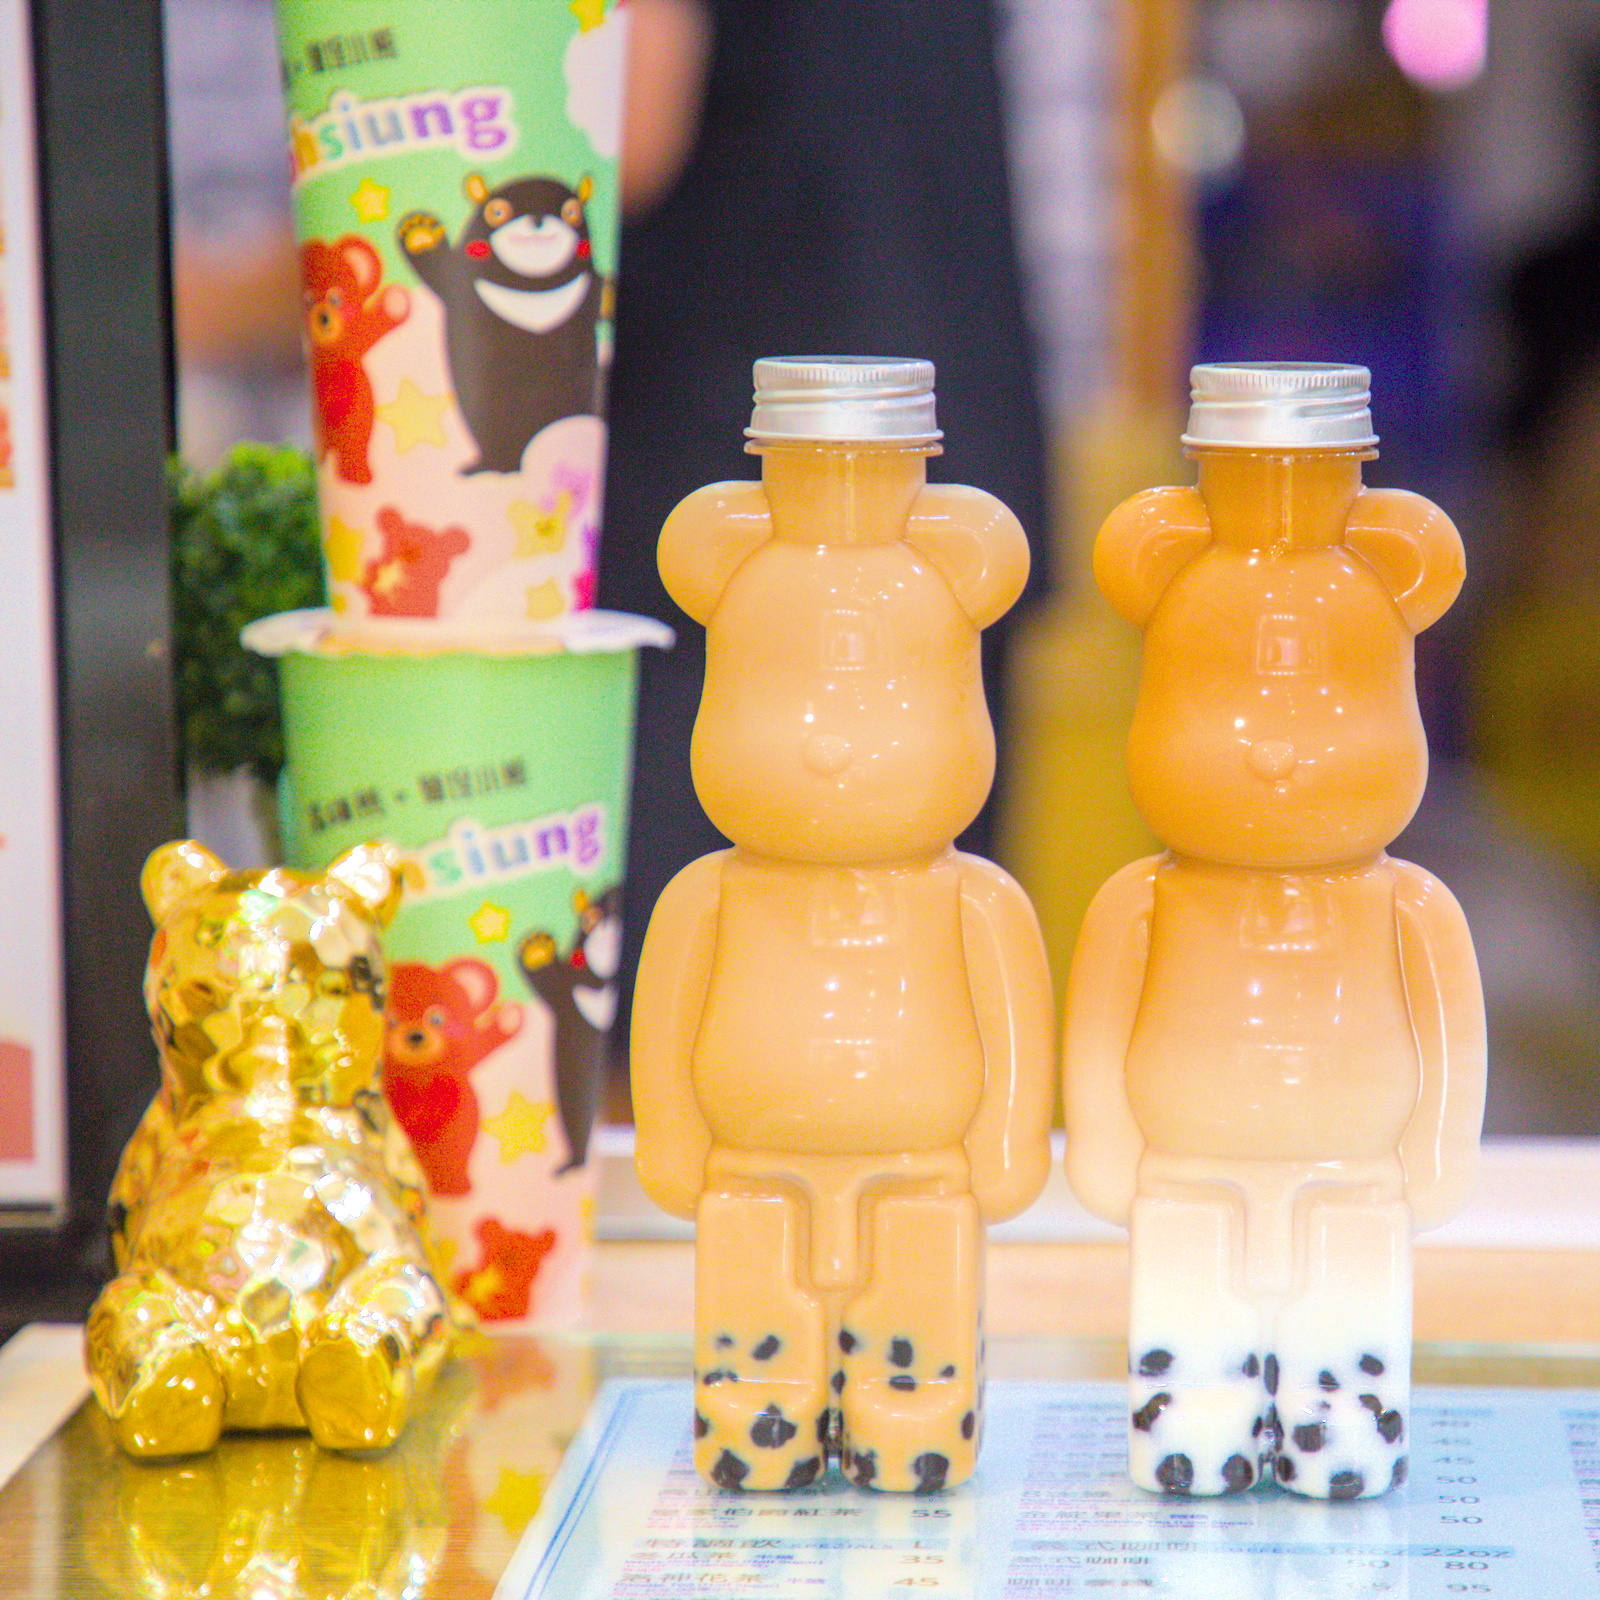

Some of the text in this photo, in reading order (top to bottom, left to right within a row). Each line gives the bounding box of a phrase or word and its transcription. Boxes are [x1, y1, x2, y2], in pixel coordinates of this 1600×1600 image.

[1436, 1475, 1478, 1485] 50
[1437, 1494, 1481, 1505] 50
[910, 1509, 954, 1519] 55
[1440, 1515, 1484, 1525] 50
[1421, 1547, 1511, 1557] 22oz
[899, 1555, 945, 1564] 35
[1444, 1560, 1489, 1570] 80
[893, 1577, 940, 1587] 45
